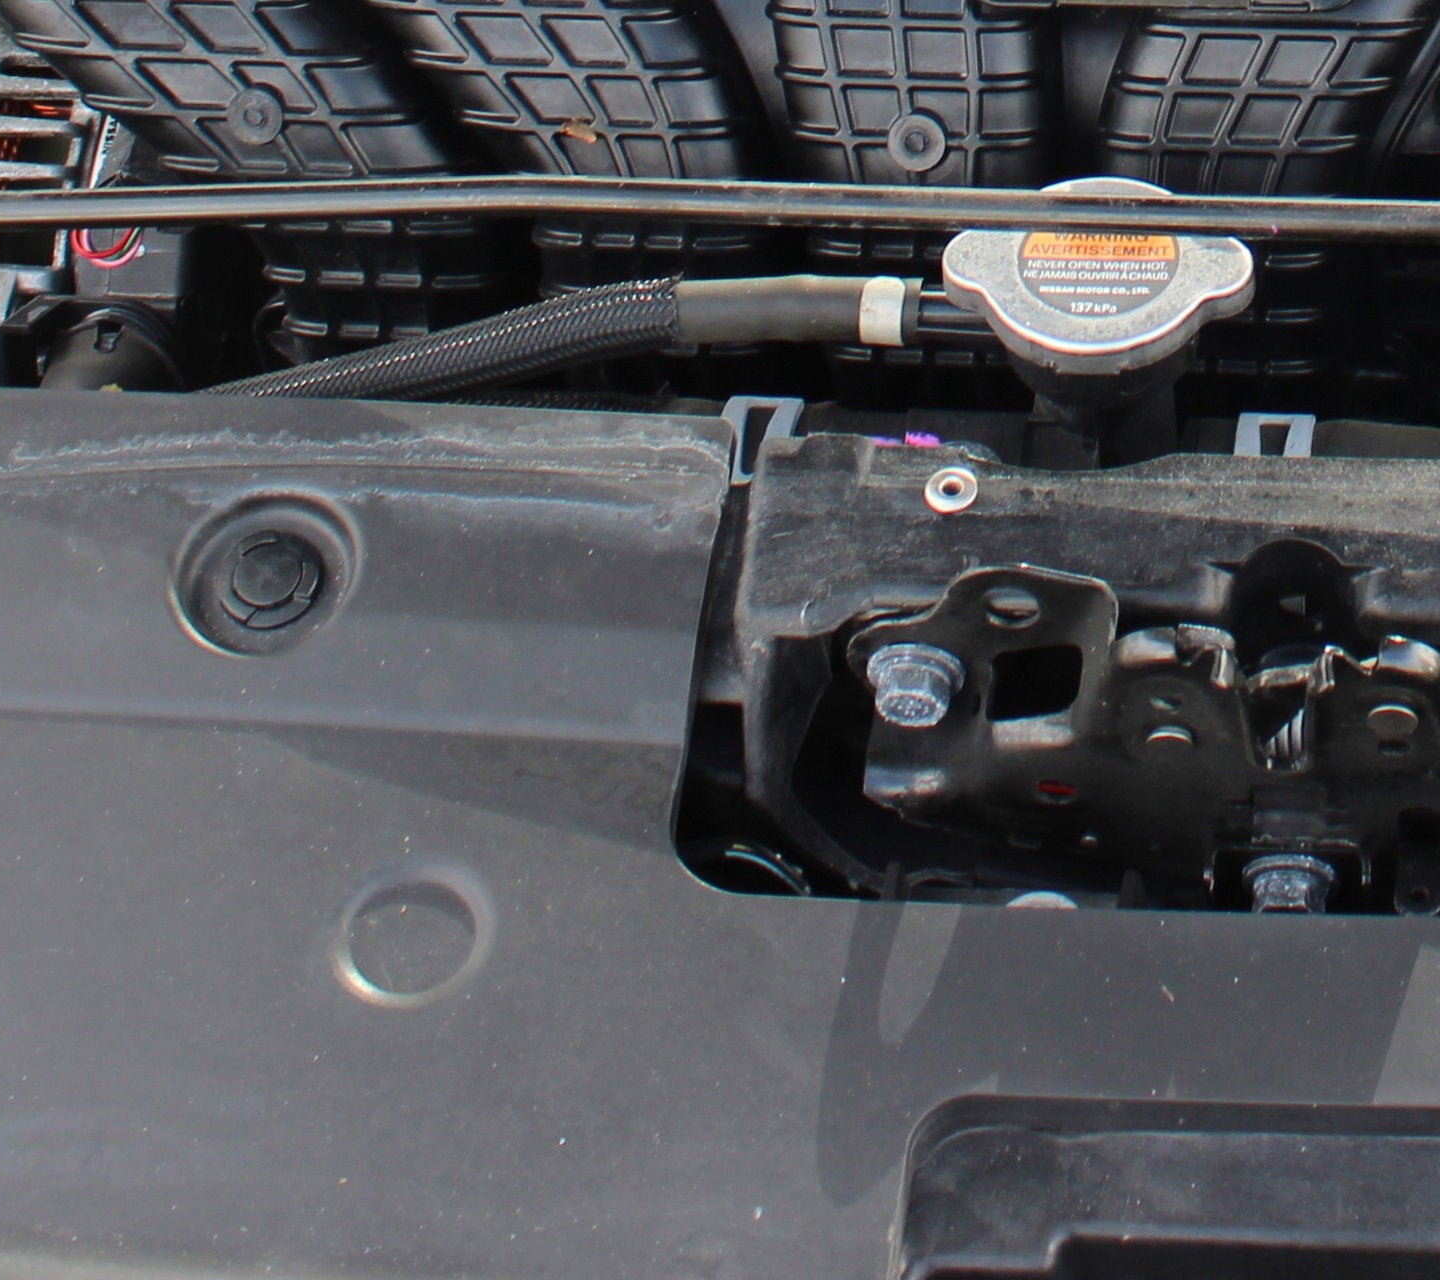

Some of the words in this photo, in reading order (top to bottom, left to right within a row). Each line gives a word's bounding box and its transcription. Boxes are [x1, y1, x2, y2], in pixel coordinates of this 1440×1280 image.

[102, 120, 117, 154] NISSA
[1029, 243, 1171, 256] AVERTISSEMENT
[1028, 260, 1066, 270] NEVER
[1068, 260, 1101, 270] OPEN
[1104, 261, 1140, 271] WHEN
[1023, 269, 1038, 279] NE
[1039, 270, 1077, 280] JAMAIS
[1039, 285, 1074, 294] NISSAN
[1076, 286, 1110, 294] MOTOR
[1070, 301, 1092, 313] 137
[1094, 301, 1117, 314] kPa
